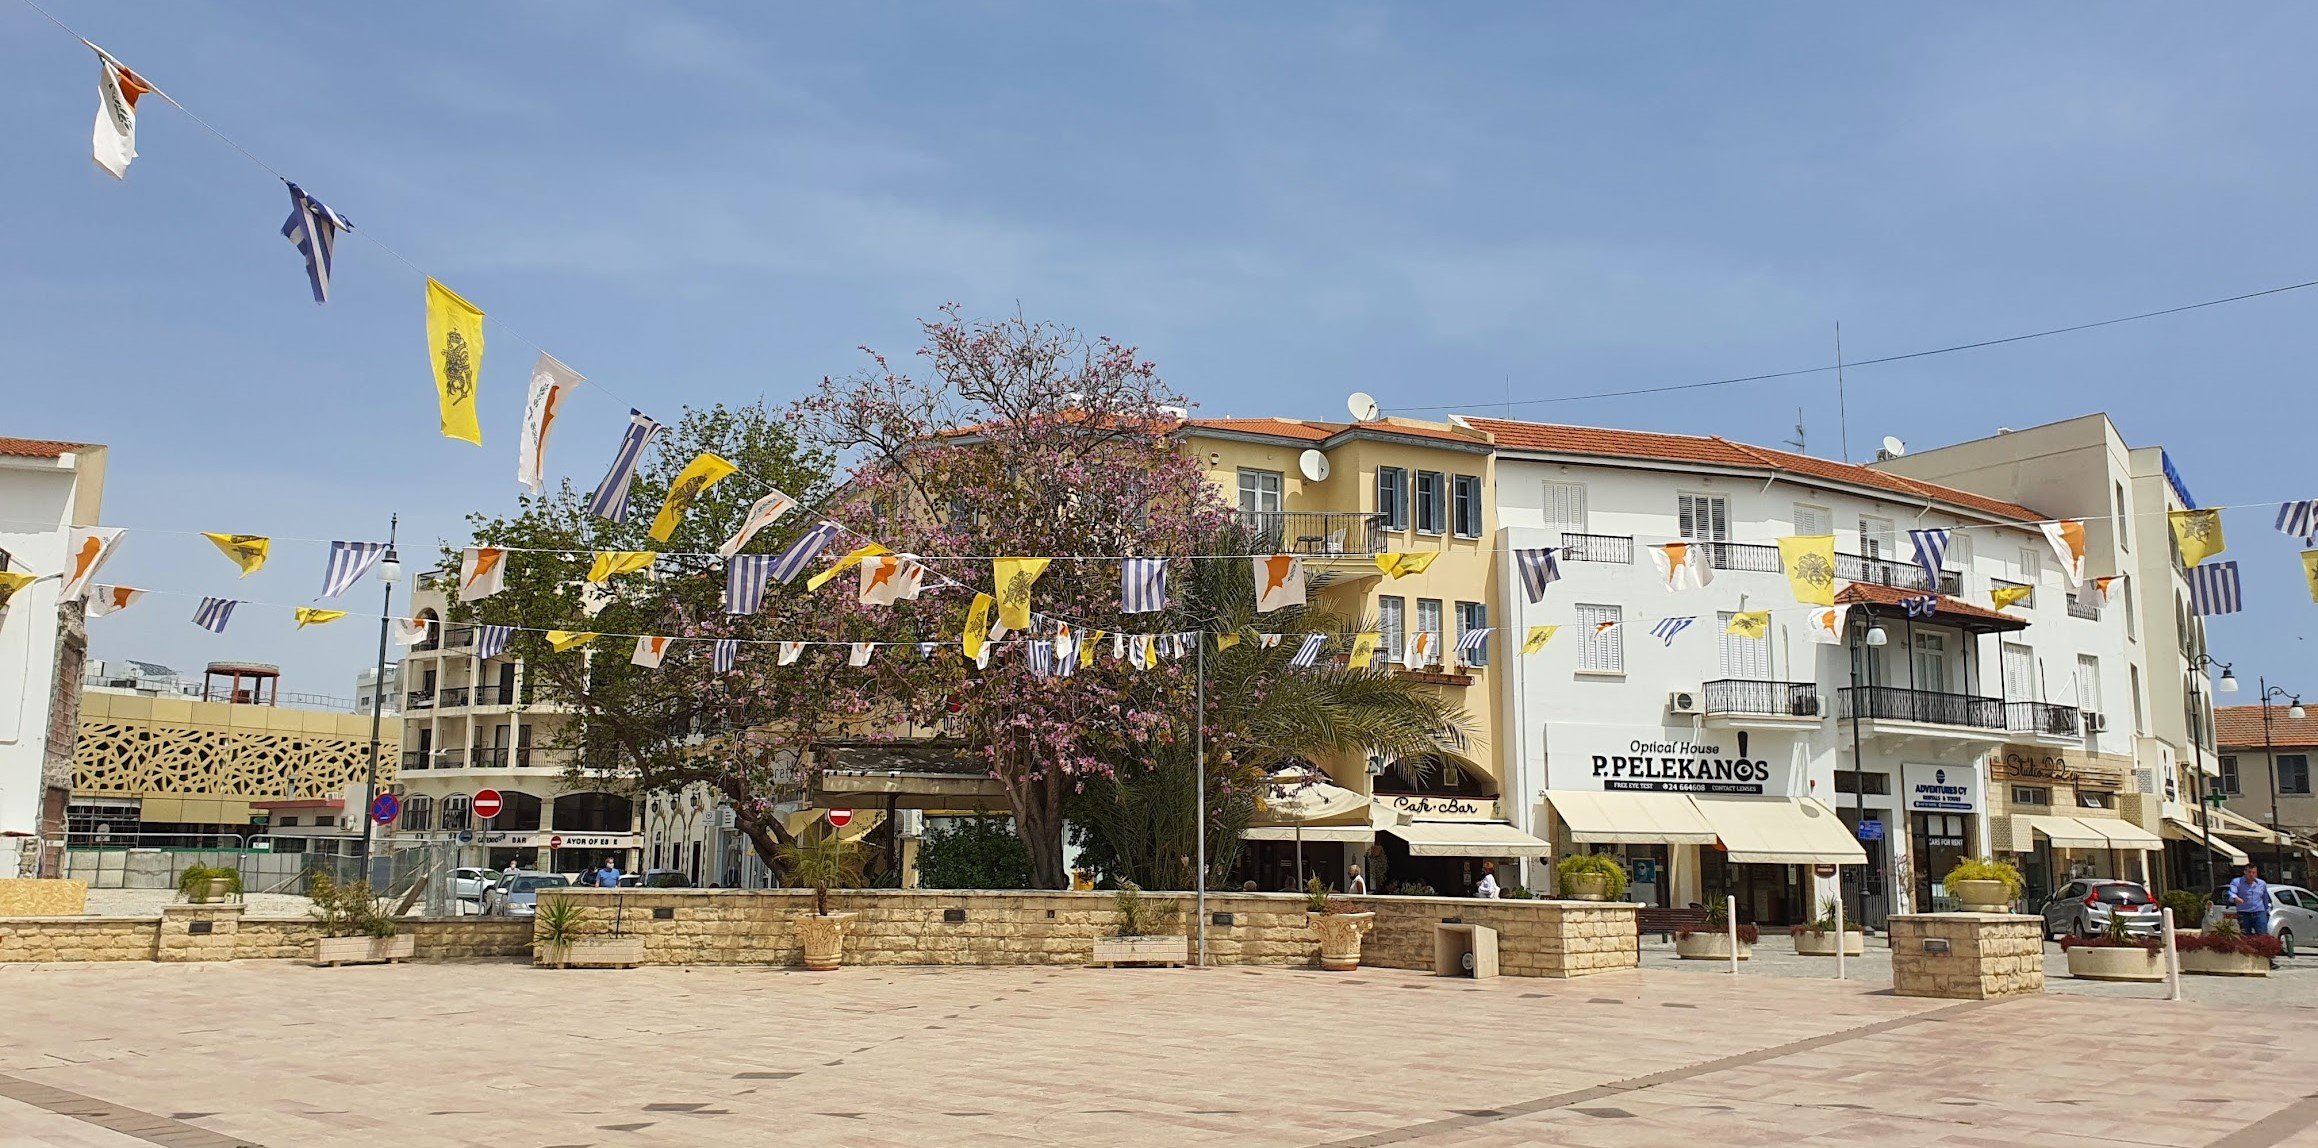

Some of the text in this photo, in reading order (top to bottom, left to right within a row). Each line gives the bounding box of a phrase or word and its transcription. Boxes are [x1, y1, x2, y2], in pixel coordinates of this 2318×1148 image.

[1630, 740, 1720, 755] Optical House
[1915, 784, 1967, 796] ADVENTURES CY
[1941, 838, 1951, 846] FOR
